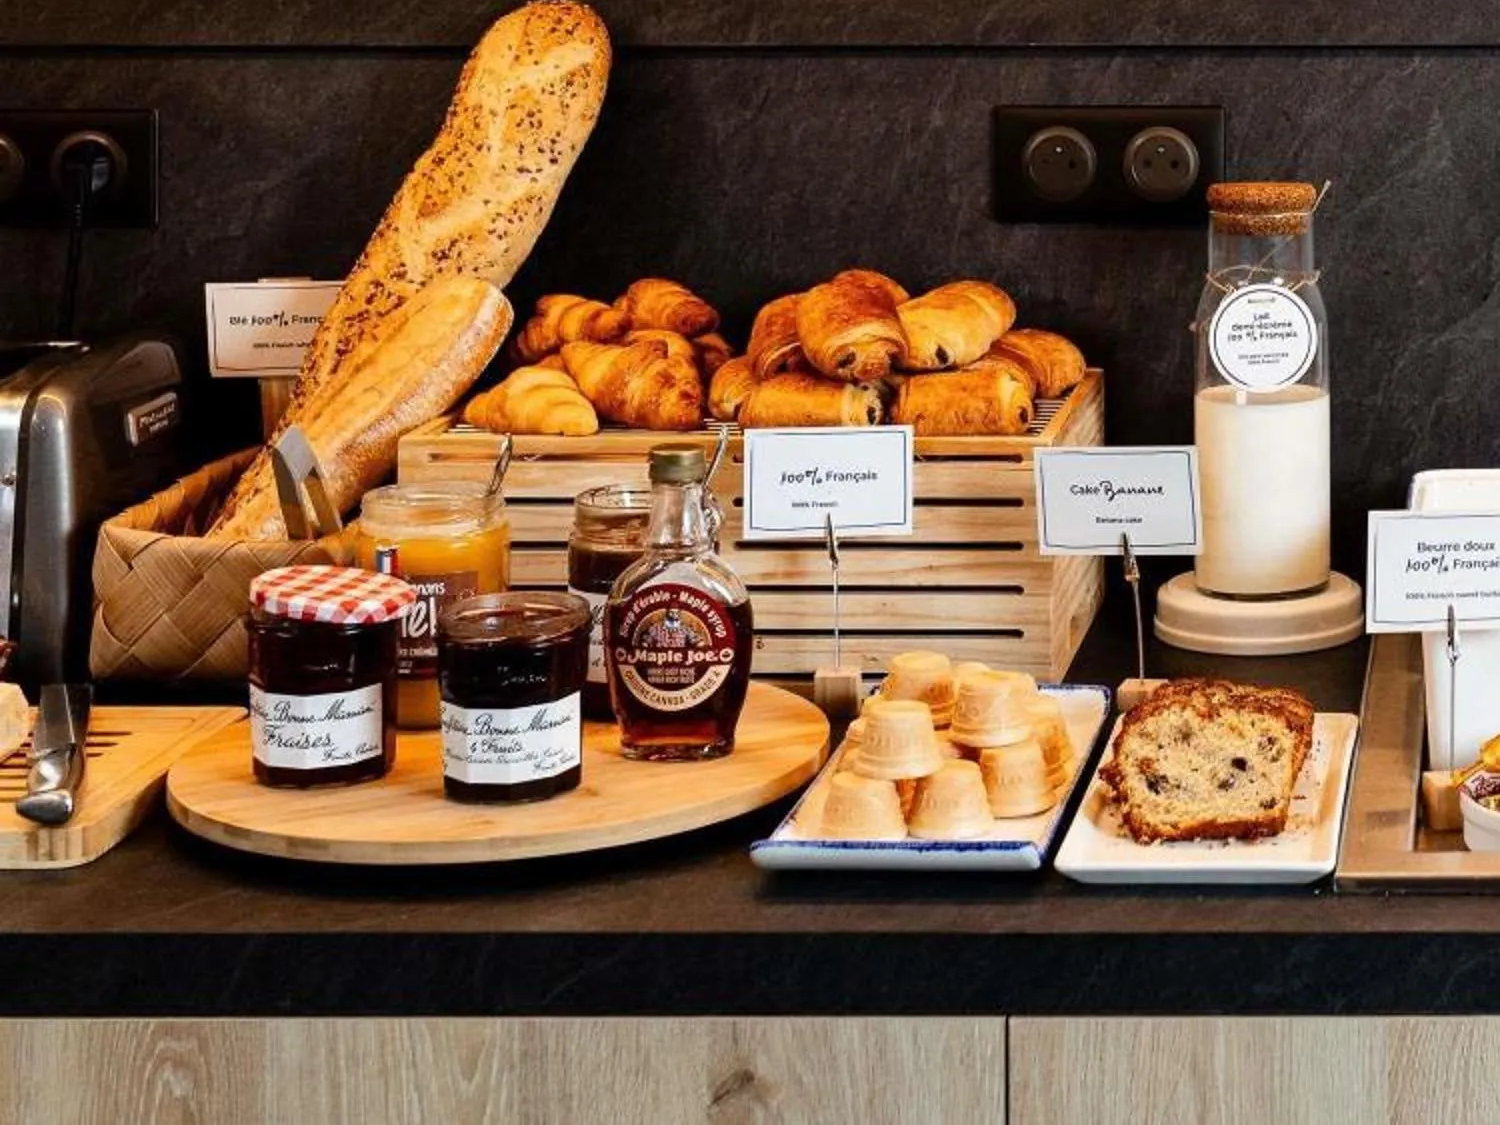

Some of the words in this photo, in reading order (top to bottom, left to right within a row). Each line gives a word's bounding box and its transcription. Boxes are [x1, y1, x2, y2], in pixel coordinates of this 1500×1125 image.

[779, 466, 823, 485] 100%
[825, 469, 879, 483] Français
[1069, 484, 1100, 496] Cake
[1099, 480, 1165, 502] Banane
[1417, 541, 1461, 554] Beurre
[1463, 540, 1496, 553] doux
[1405, 554, 1449, 574] 100%
[679, 591, 710, 613] Maple
[627, 649, 683, 665] Maple
[684, 650, 718, 666] Joe
[267, 700, 316, 724] Bonne
[474, 713, 519, 736] Bonne
[263, 724, 334, 750] Fraises
[481, 737, 523, 754] Fruits
